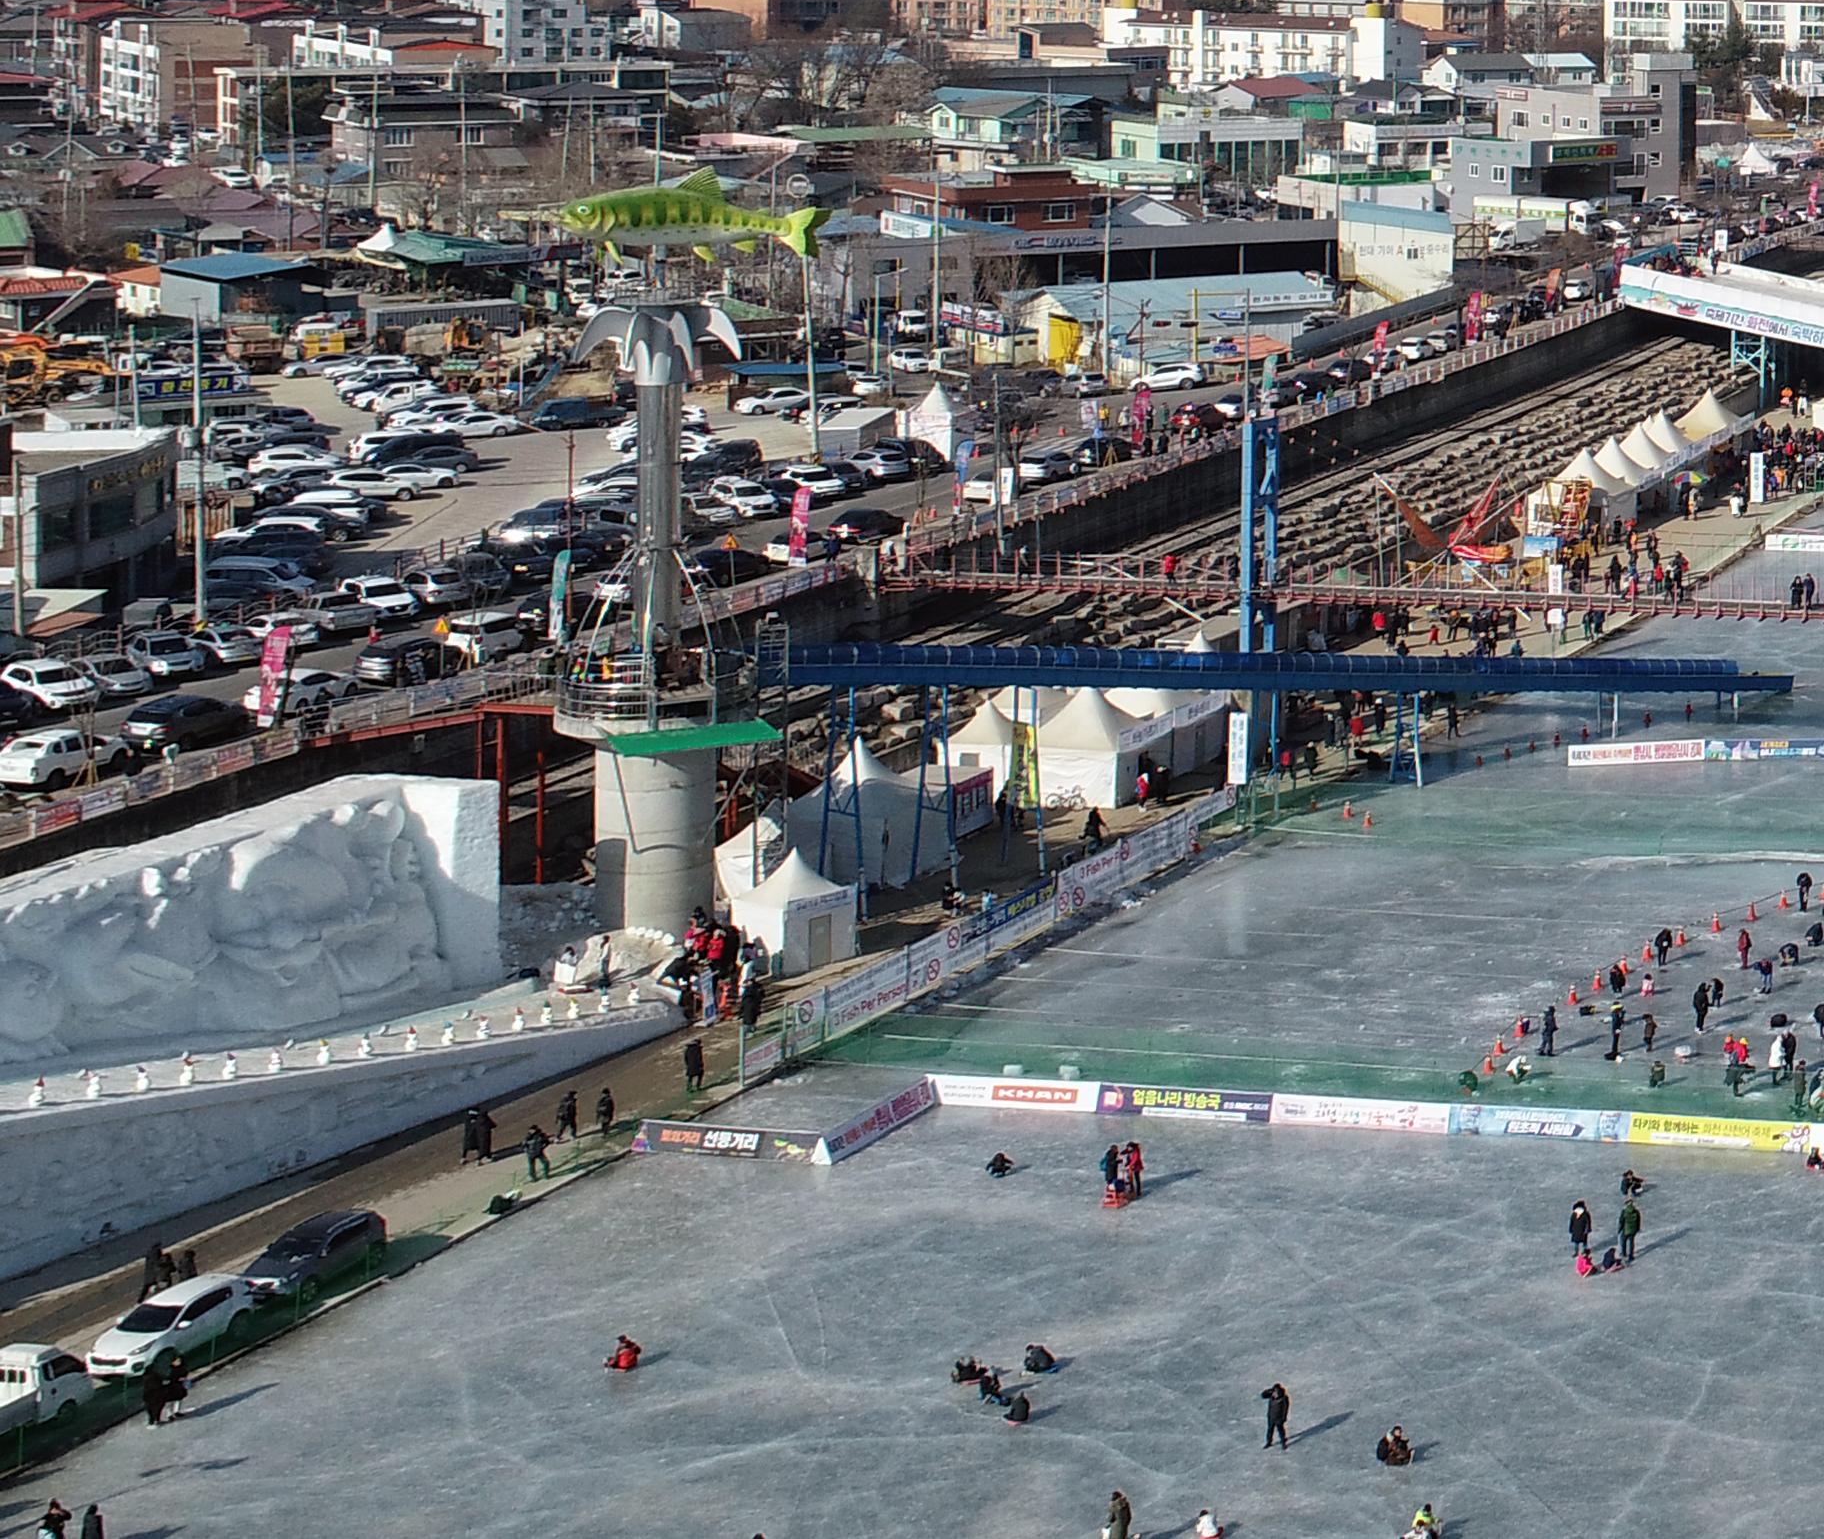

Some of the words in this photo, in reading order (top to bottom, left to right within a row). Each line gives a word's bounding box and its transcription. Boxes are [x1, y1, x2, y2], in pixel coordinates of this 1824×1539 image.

[1704, 306, 1745, 327] 축제기간
[1746, 315, 1788, 337] 화천에서
[841, 1006, 861, 1022] Fish
[861, 998, 876, 1013] Per
[997, 1088, 1073, 1101] KHAN
[1132, 1089, 1182, 1108] 얼음나라
[1183, 1092, 1222, 1111] 방송국
[1632, 1118, 1660, 1131] 타키와
[1663, 1121, 1699, 1134] 함께하는
